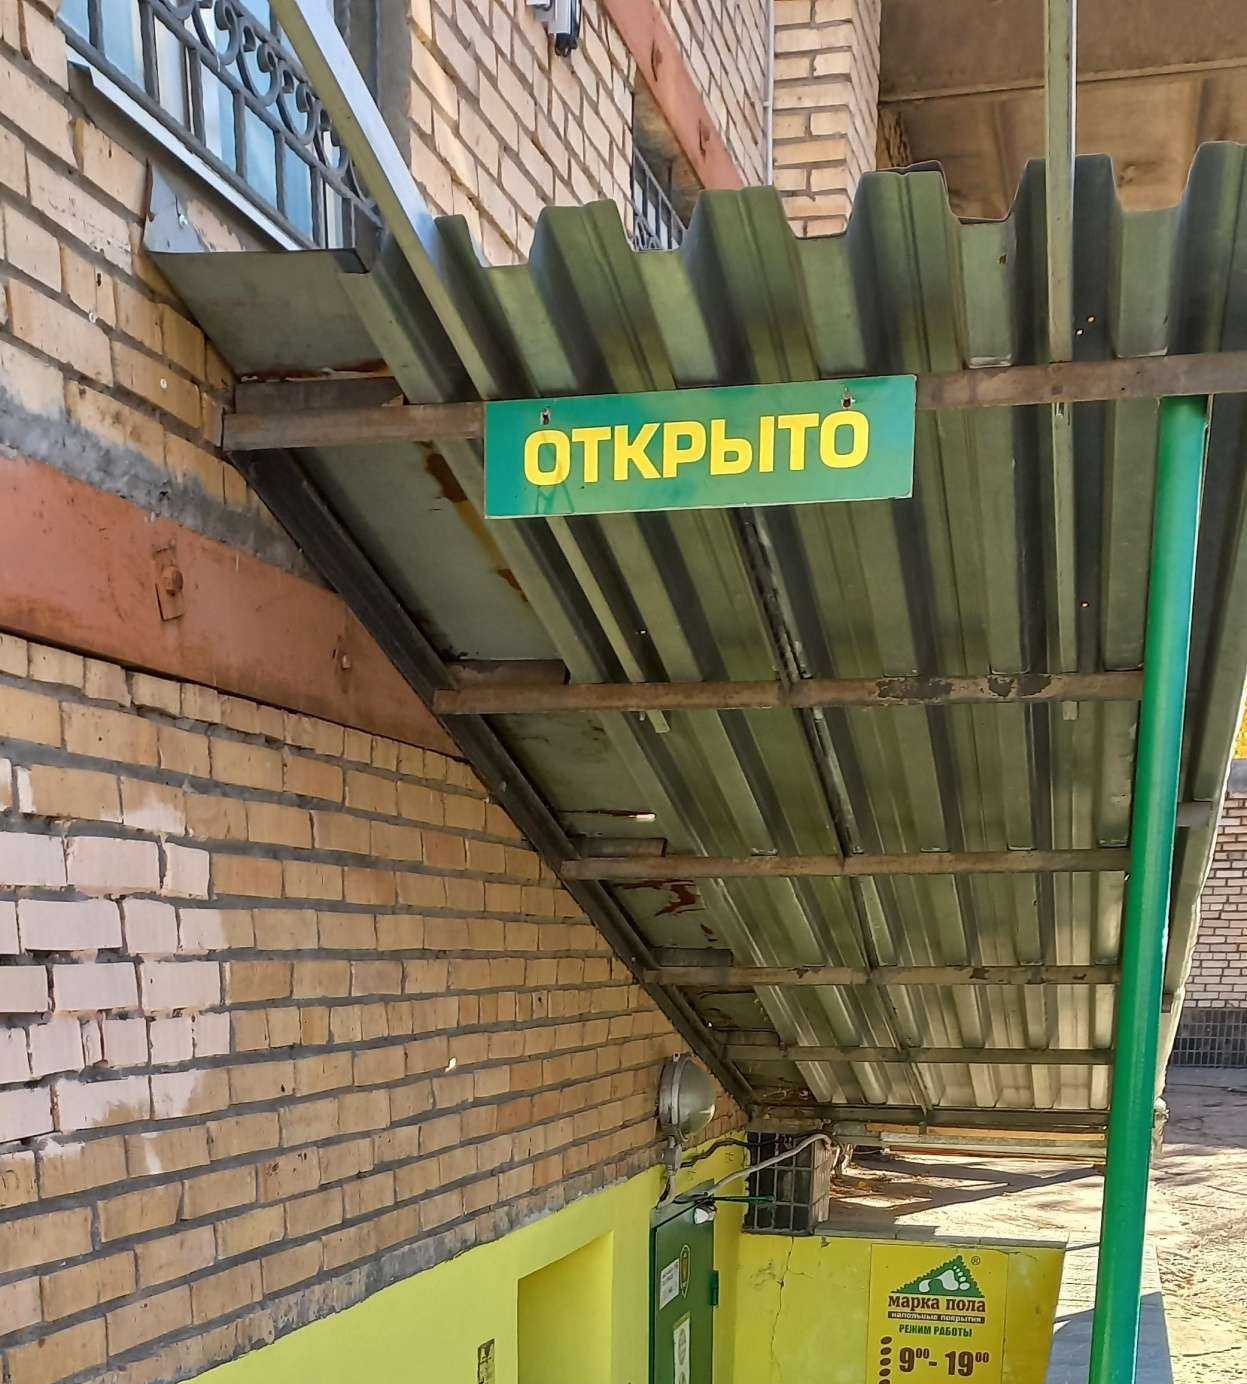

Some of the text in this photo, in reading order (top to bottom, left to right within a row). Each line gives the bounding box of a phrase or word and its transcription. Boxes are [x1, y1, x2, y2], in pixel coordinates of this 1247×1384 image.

[523, 410, 870, 486] ОТКРЫТО
[888, 1295, 986, 1313] марка пола
[899, 1324, 972, 1337] РЕЖИМ РАБОТЫ
